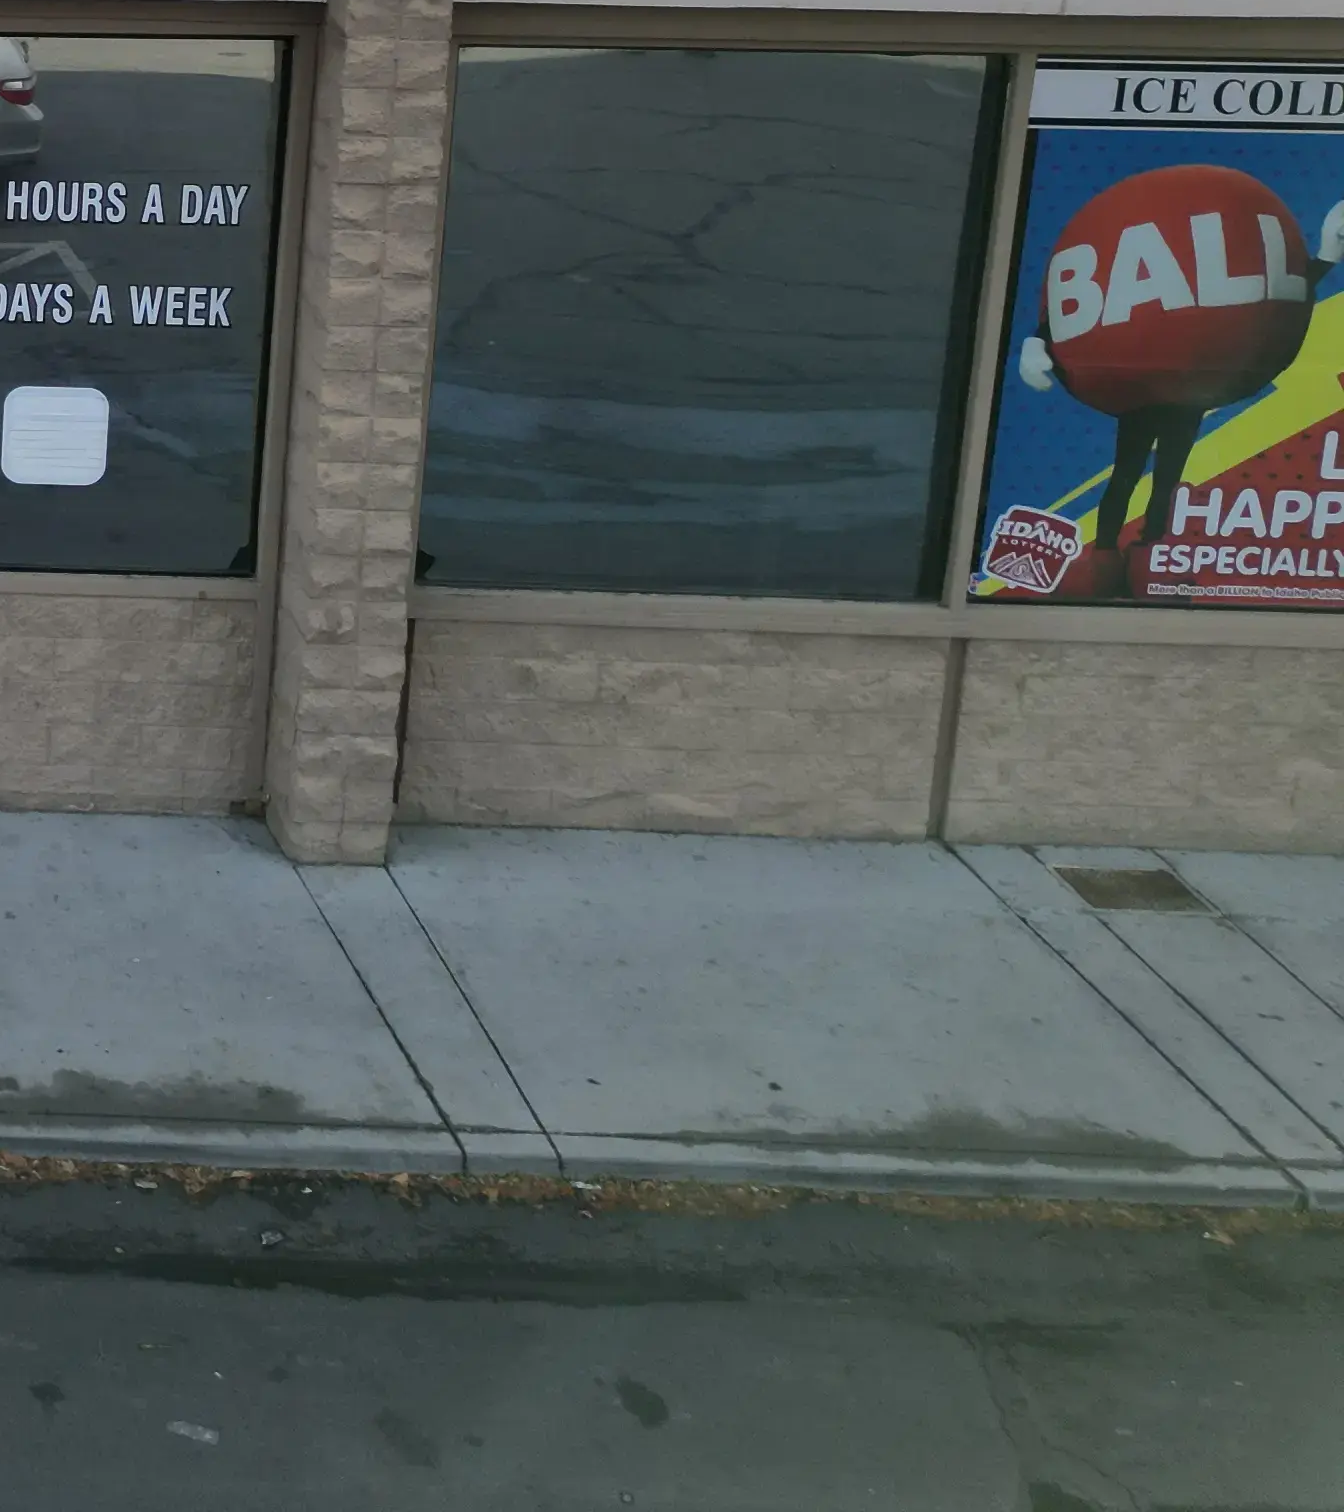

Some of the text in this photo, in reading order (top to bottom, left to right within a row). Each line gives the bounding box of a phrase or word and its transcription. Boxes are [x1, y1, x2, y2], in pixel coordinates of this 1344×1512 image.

[1111, 77, 1344, 116] ICE COLD
[7, 180, 127, 223] HOURS
[141, 183, 164, 224] A
[180, 184, 249, 225] DAY
[1047, 212, 1307, 343] BALL
[88, 285, 113, 324] A
[129, 285, 232, 327] WEEK
[1172, 487, 1344, 539] HAPP
[998, 520, 1078, 555] IDAHO
[1002, 538, 1062, 559] LOTTERY
